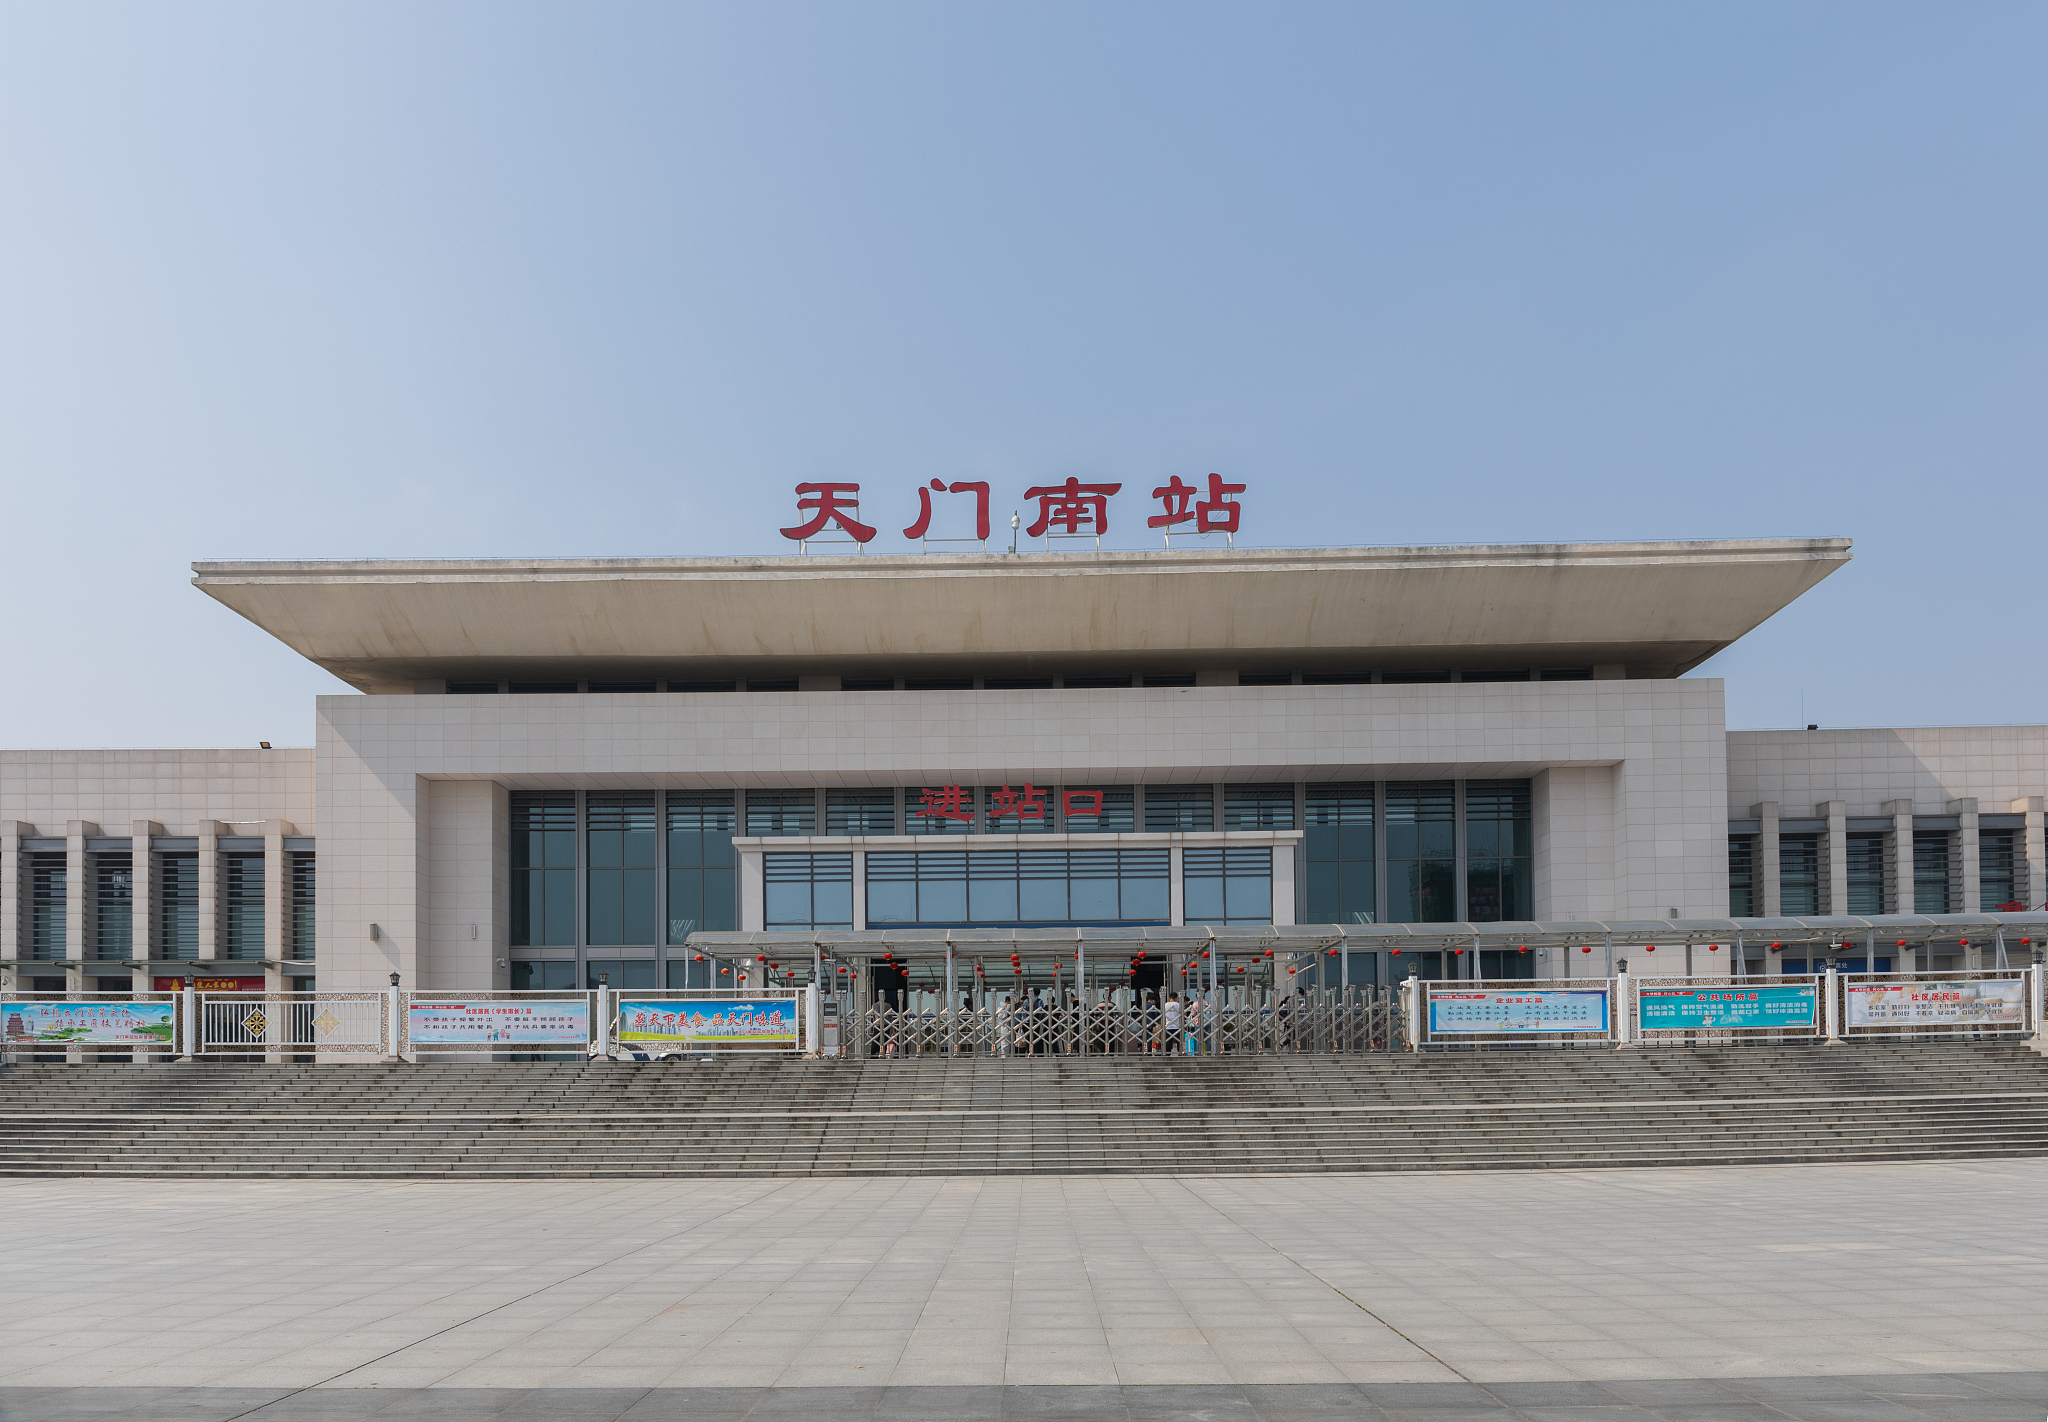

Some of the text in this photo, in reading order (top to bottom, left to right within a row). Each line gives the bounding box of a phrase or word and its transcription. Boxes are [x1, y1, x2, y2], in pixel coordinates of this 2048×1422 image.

[780, 472, 1247, 543] 天门南站
[915, 783, 1104, 822] 进站口
[1697, 993, 1759, 1001] 公共场所篇
[1911, 992, 1961, 1001] 社区居民篇
[634, 1010, 785, 1027] 蒸天下美食 品天门味道
